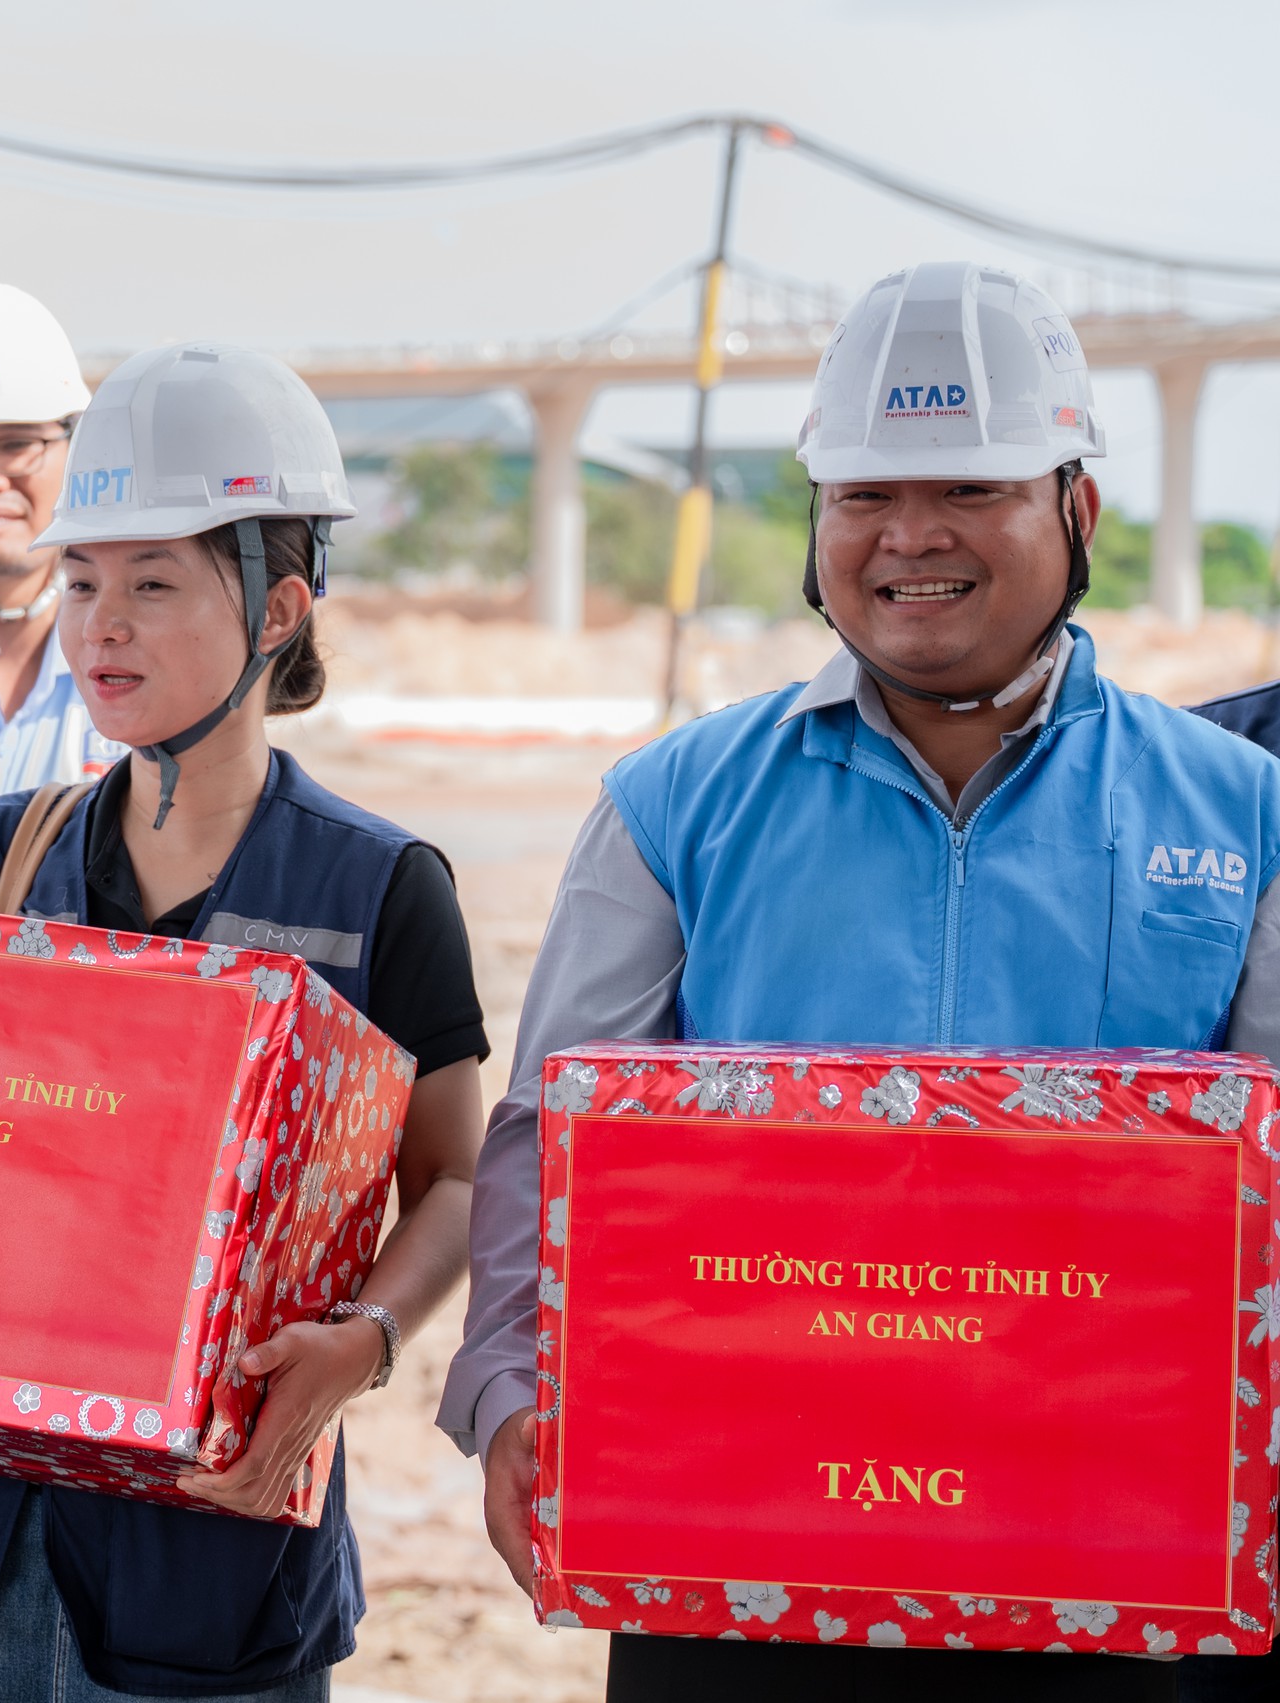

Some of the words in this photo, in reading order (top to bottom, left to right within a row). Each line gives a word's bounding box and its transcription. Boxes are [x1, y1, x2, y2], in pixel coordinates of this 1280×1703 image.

[884, 410, 931, 418] Partnership
[885, 384, 966, 410] ATAD
[70, 467, 131, 508] NPT
[1146, 845, 1247, 882] ATAD
[1146, 872, 1204, 887] Partnership
[4, 1072, 78, 1109] TỈNH
[84, 1082, 126, 1115] ỦY
[689, 1250, 844, 1288] THƯỜNG
[852, 1261, 952, 1297] TRỰC
[961, 1260, 1049, 1296] TỈNH
[1059, 1263, 1110, 1298] ỦY
[807, 1310, 858, 1337] AN
[866, 1311, 984, 1343] GIANG
[817, 1457, 967, 1511] TẶNG
